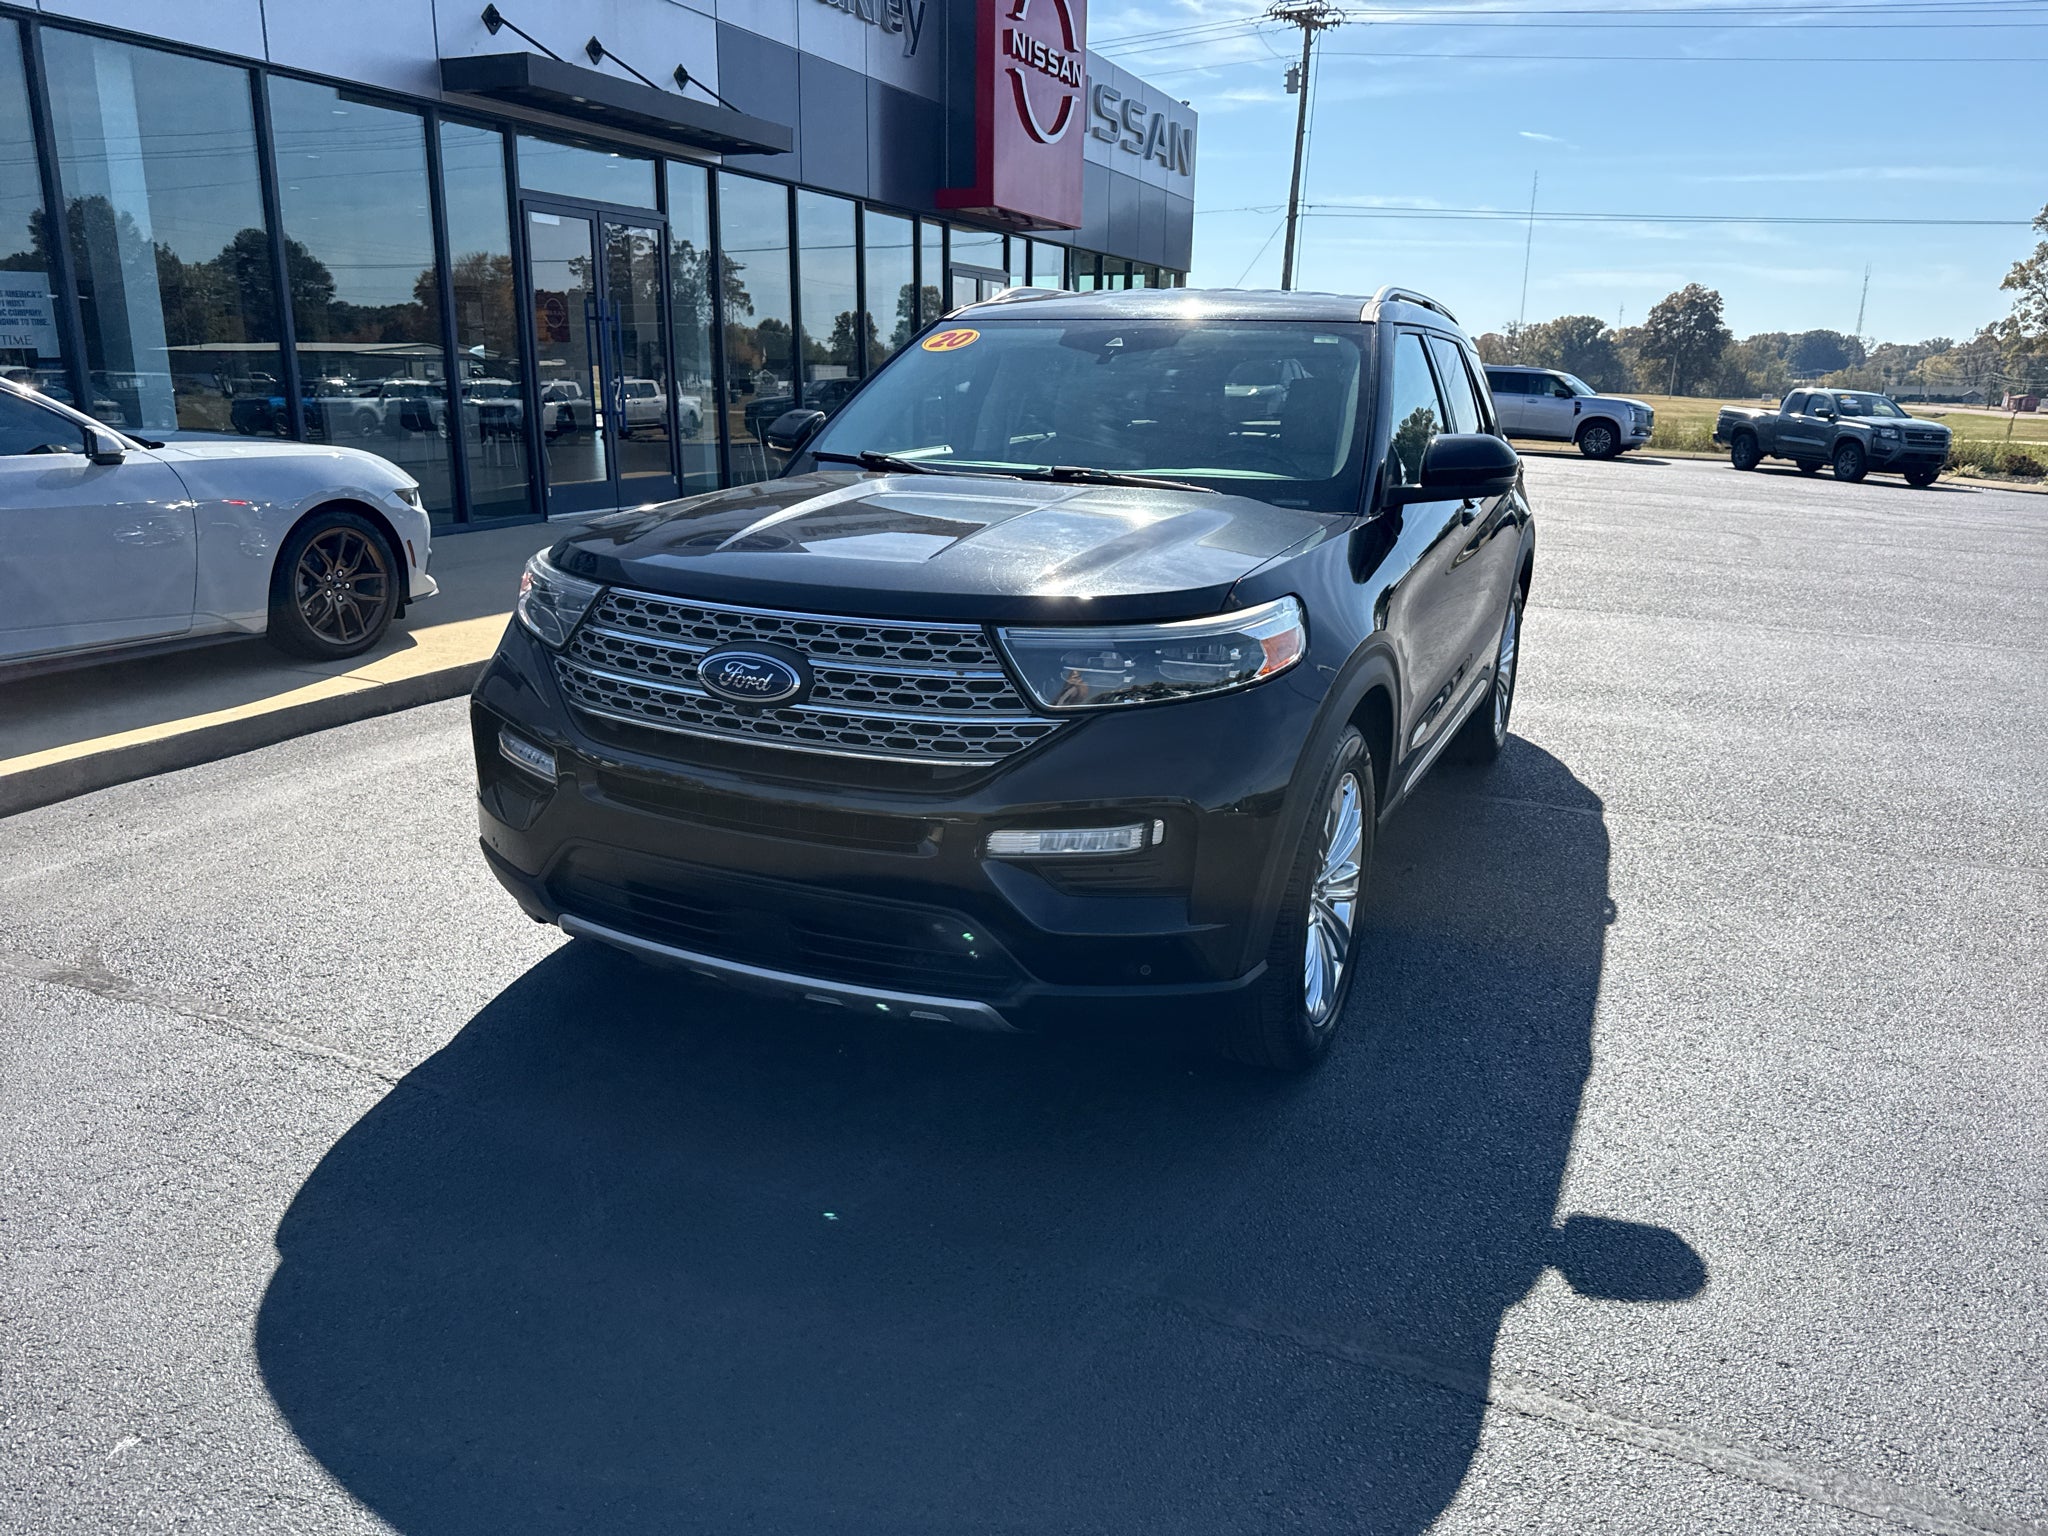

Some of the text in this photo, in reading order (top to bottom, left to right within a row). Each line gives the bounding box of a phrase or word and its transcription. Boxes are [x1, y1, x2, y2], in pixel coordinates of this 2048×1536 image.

[1006, 28, 1083, 88] NISSAN
[1086, 75, 1193, 176] ISSAN
[1, 334, 33, 346] TIME
[929, 332, 974, 348] 20
[719, 660, 774, 692] Ford
